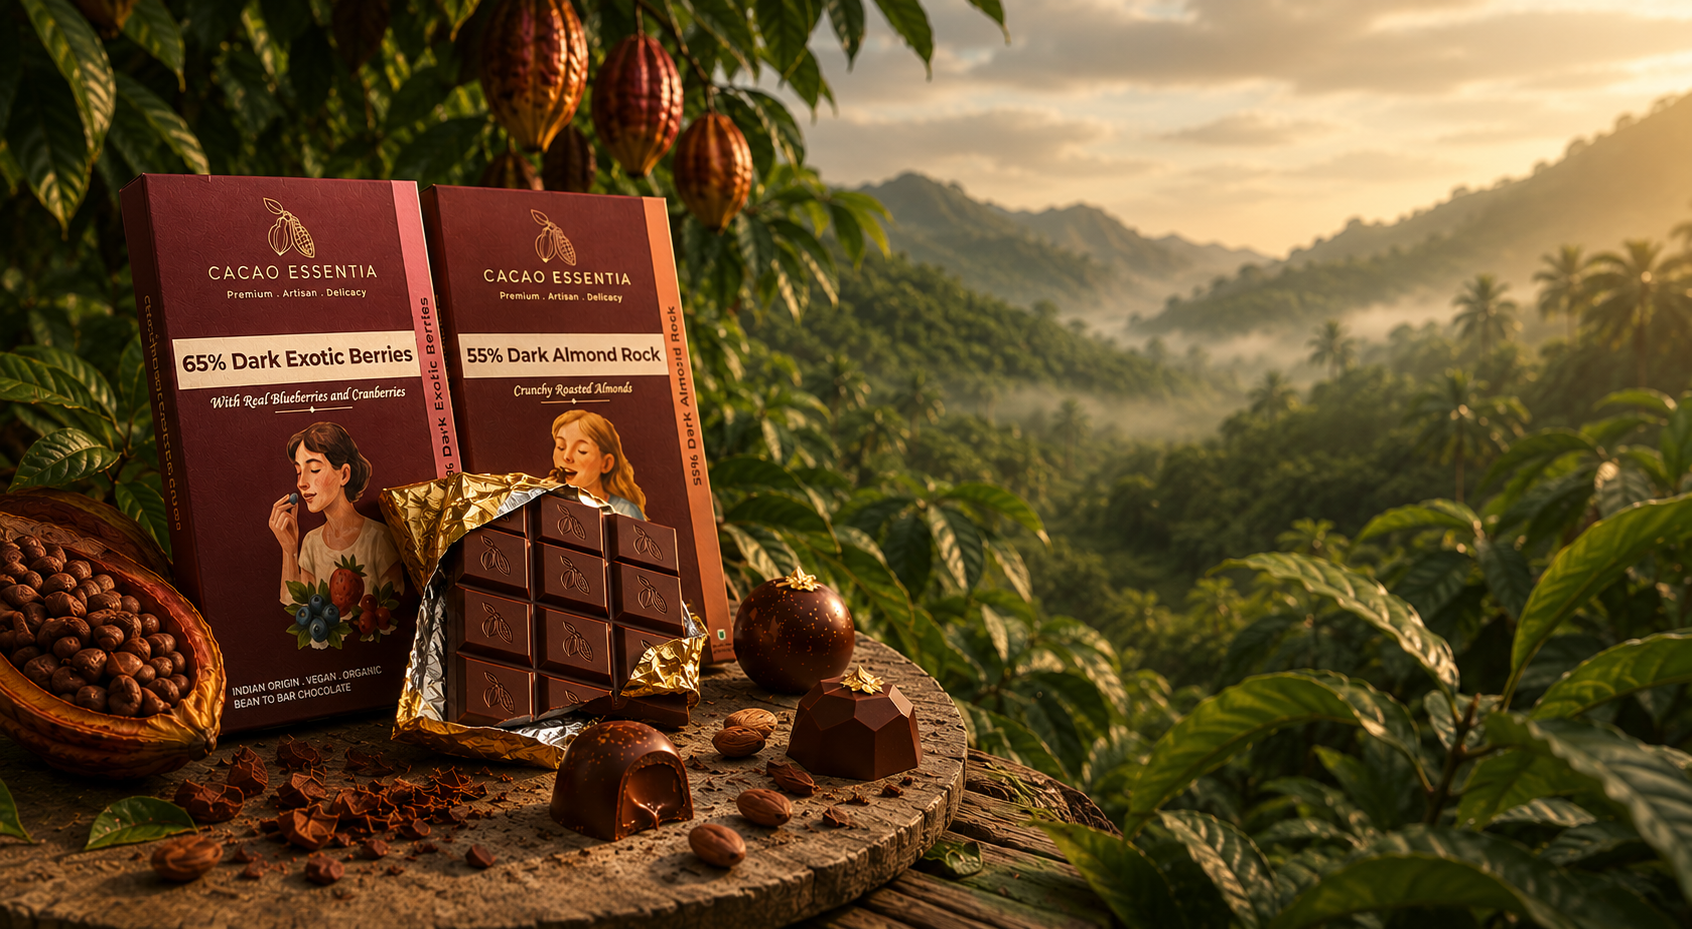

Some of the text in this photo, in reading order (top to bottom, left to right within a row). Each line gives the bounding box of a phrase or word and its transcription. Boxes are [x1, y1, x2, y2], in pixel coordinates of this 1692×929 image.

[208, 264, 378, 280] CACAO ESSENTIA
[483, 268, 631, 286] CACAO ESSENTIA
[227, 289, 273, 299] Premium
[283, 288, 317, 298] Artisan
[326, 287, 367, 298] Delicacy
[500, 291, 540, 301] Premium
[548, 292, 579, 301] Artisan
[587, 292, 623, 304] Delicacy
[420, 297, 436, 355] Berries
[667, 305, 680, 342] Rock
[182, 344, 413, 373] 65% Dark Exotic Berries
[467, 346, 661, 364] 55% Dark Almond Rock
[210, 386, 406, 409] With Real Blueberries and Cranberries
[428, 360, 444, 411] Exotic
[513, 381, 633, 399] Crunchy Roasted Almonds
[437, 417, 452, 458] Dark
[683, 411, 697, 450] Dark
[232, 683, 266, 697] INDIAN
[267, 677, 300, 692] ORIGIN
[305, 672, 337, 685] VEGAN
[342, 665, 383, 680] ORGANIC
[234, 682, 352, 709] BEAN TO BAR CHOCOLATE
